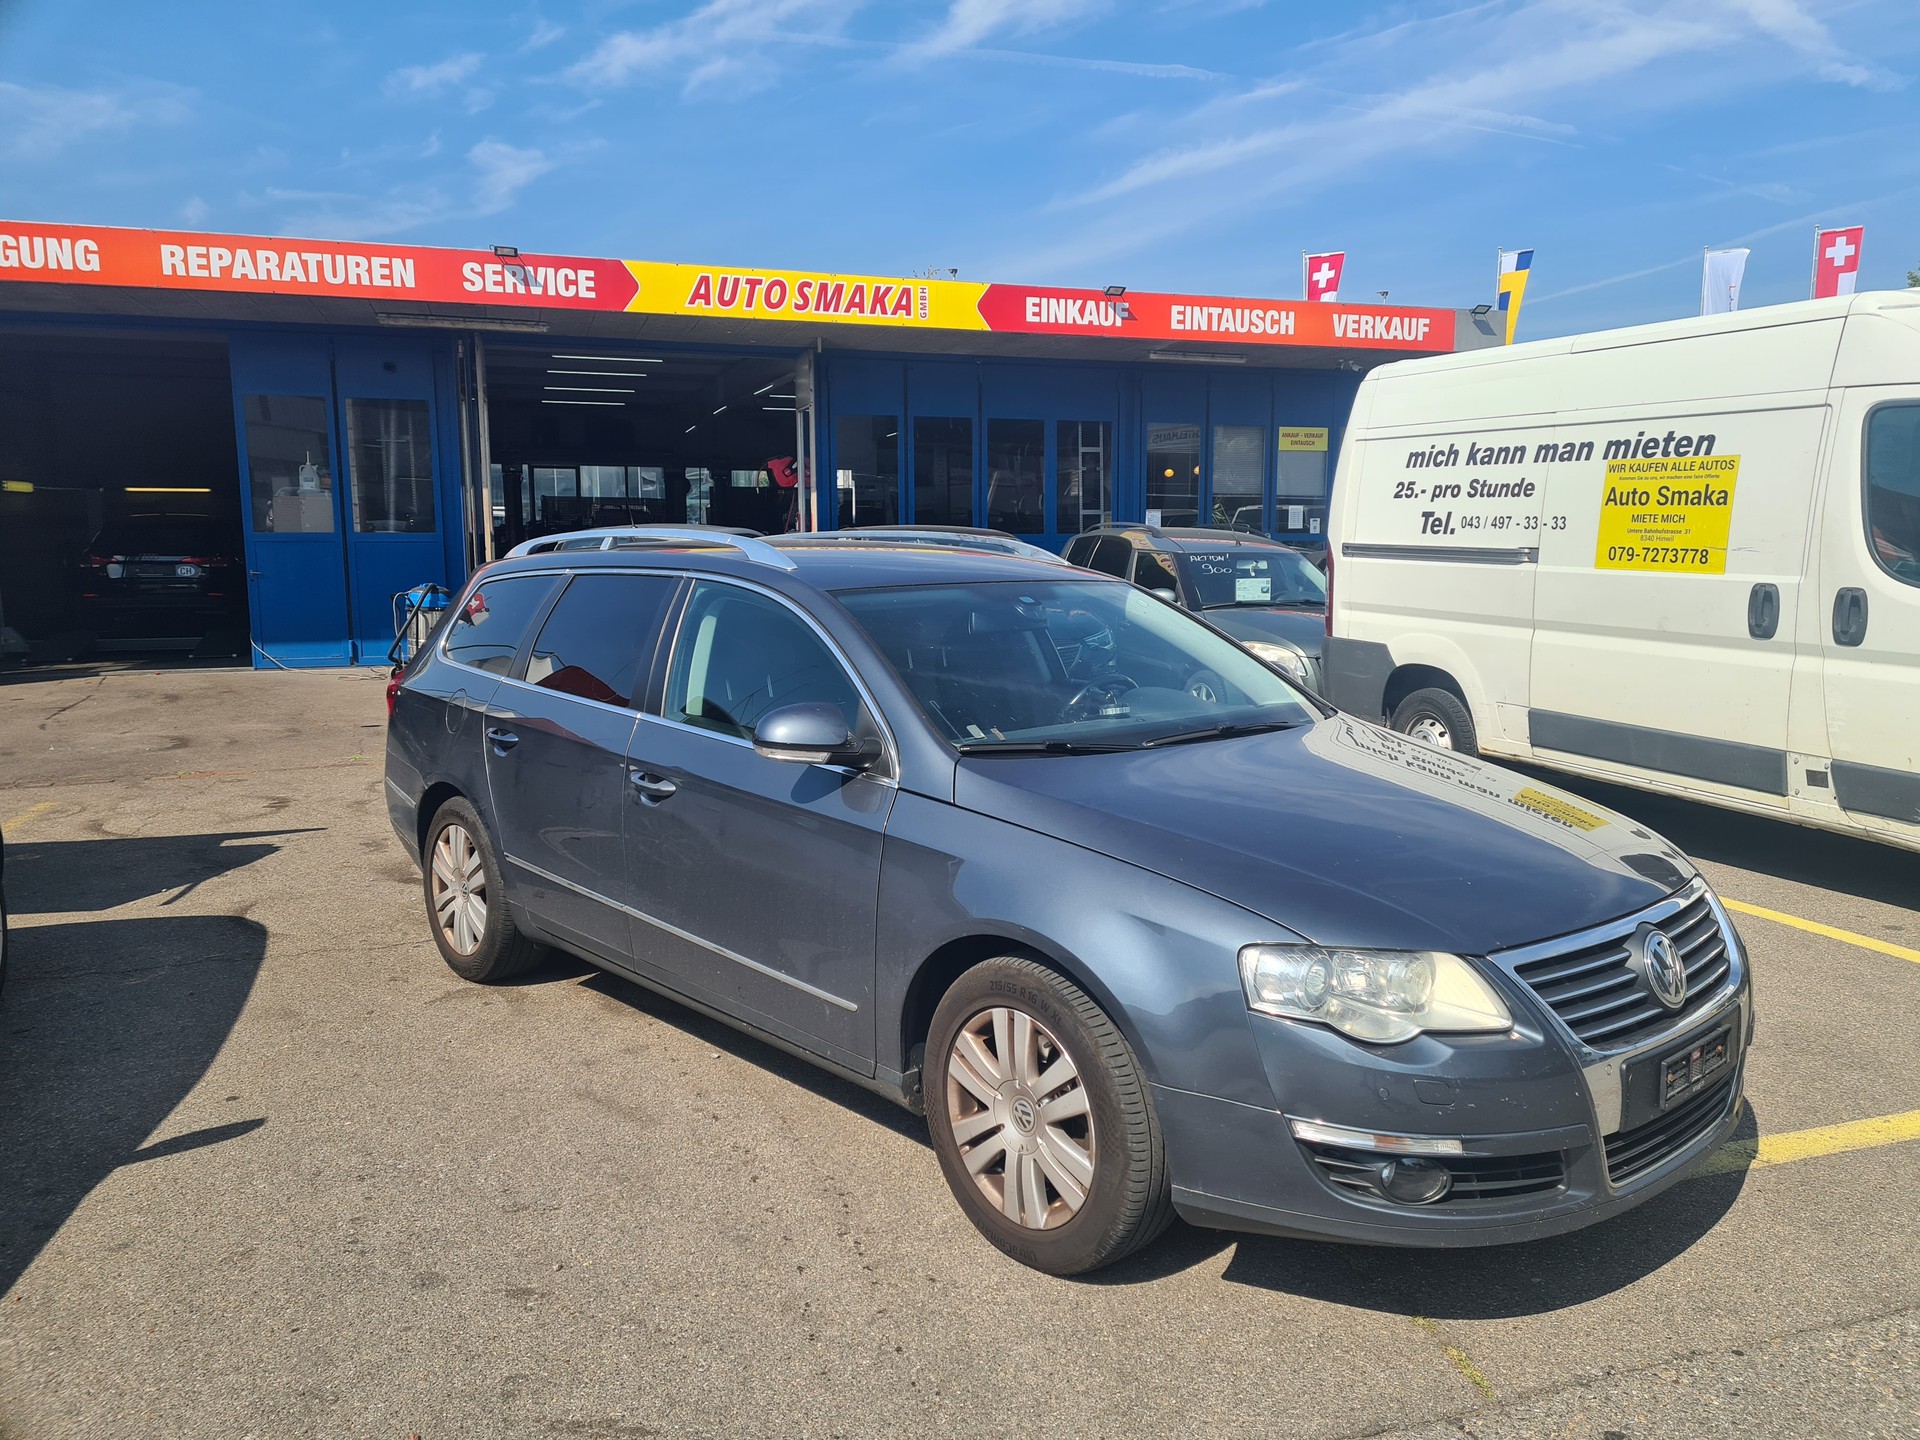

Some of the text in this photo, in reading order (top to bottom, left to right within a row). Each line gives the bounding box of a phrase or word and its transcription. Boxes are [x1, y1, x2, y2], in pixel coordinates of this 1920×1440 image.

[160, 243, 416, 289] REPARATUREN
[462, 261, 597, 299] SERVICE
[687, 273, 914, 318] AUTO SMAKA
[919, 286, 929, 319] GMBH
[1025, 297, 1130, 328] EINKAUF
[1170, 305, 1295, 336] EINTAUSCH
[1332, 312, 1430, 342] VERKAUF
[1405, 431, 1716, 469] mich kann man mieten
[1608, 459, 1736, 474] WIR KAUFEN ALLE AUTOS
[1393, 477, 1536, 503] 25.- pro Stunde
[1604, 483, 1729, 506] Auto Smaka
[1421, 511, 1456, 535] Tel.
[1461, 515, 1481, 530] 043
[1491, 515, 1513, 530] 497
[1523, 515, 1539, 531] 33
[1551, 515, 1567, 531] 33
[1631, 513, 1687, 524] MIETE MICH
[1643, 527, 1683, 535] Bahnhofstrasse
[1608, 545, 1709, 566] 079-7273778
[180, 567, 192, 576] CH
[989, 980, 1018, 995] 215/55
[1020, 986, 1027, 999] R
[1028, 991, 1038, 1005] 16
